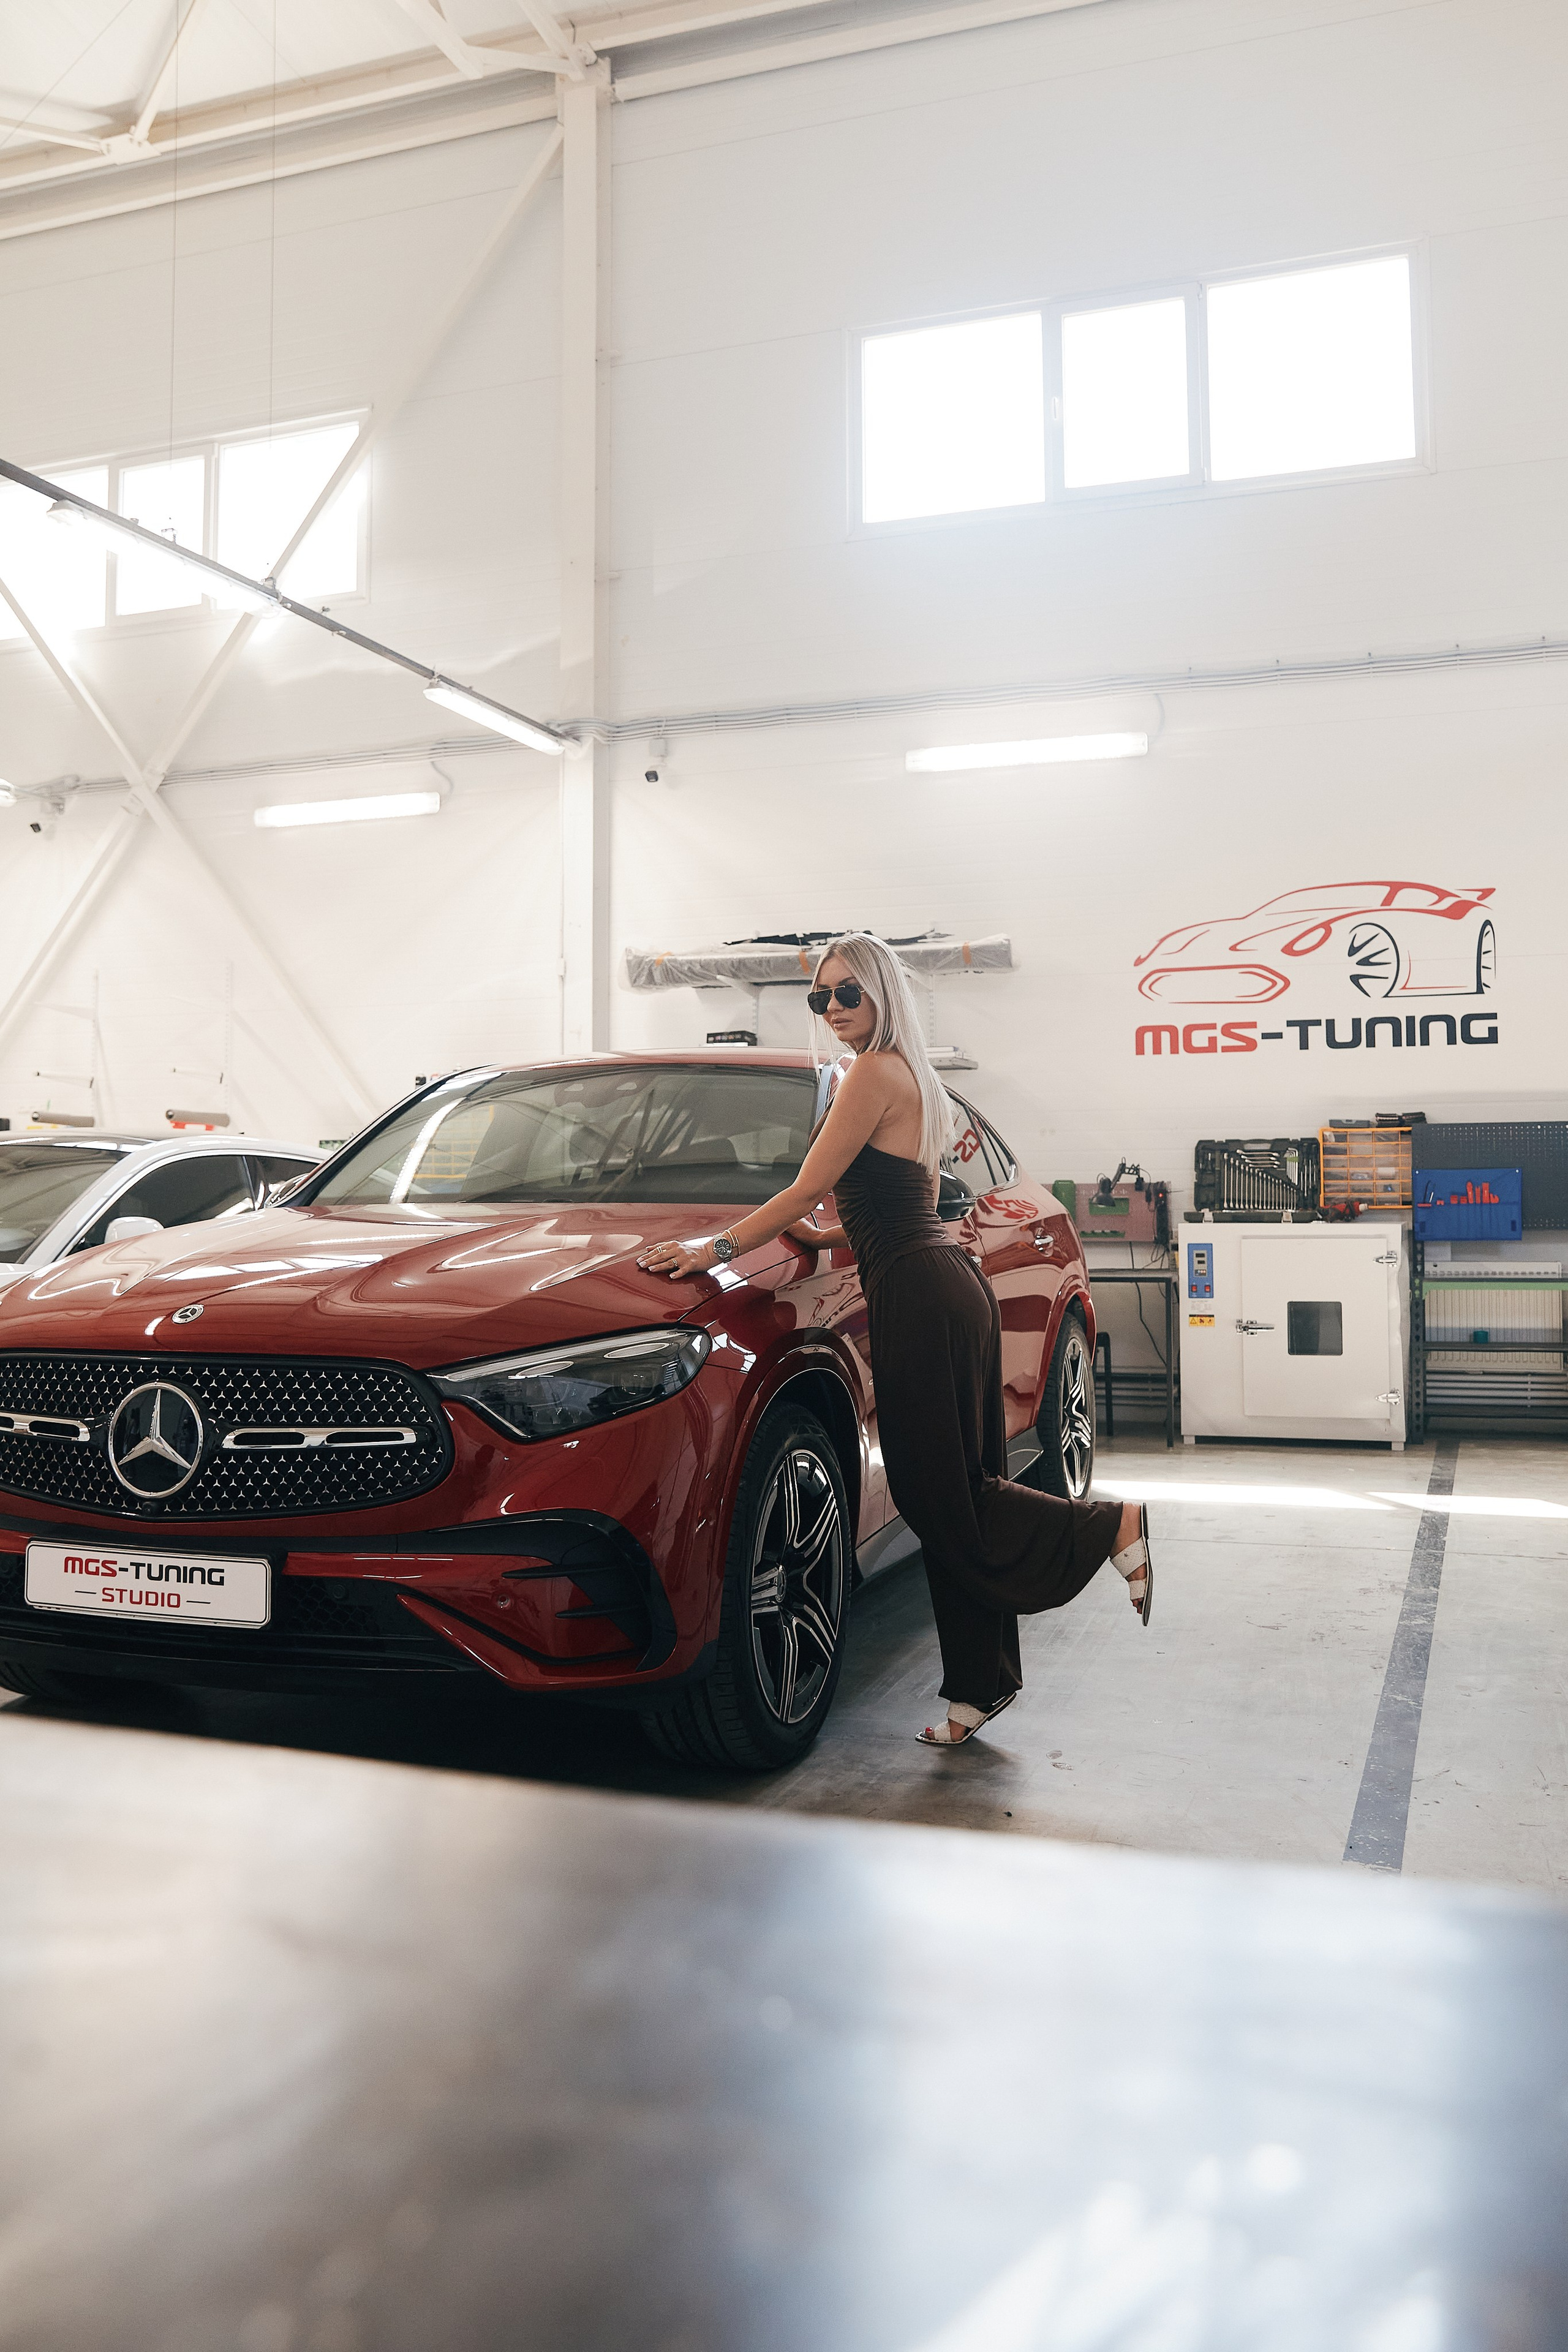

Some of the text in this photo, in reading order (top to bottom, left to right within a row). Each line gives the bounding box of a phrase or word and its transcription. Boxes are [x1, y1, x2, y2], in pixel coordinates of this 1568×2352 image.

[1135, 1012, 1499, 1055] MGS-TUNING
[64, 1556, 225, 1586] MGS-TUNING
[102, 1587, 181, 1608] STUDIO
